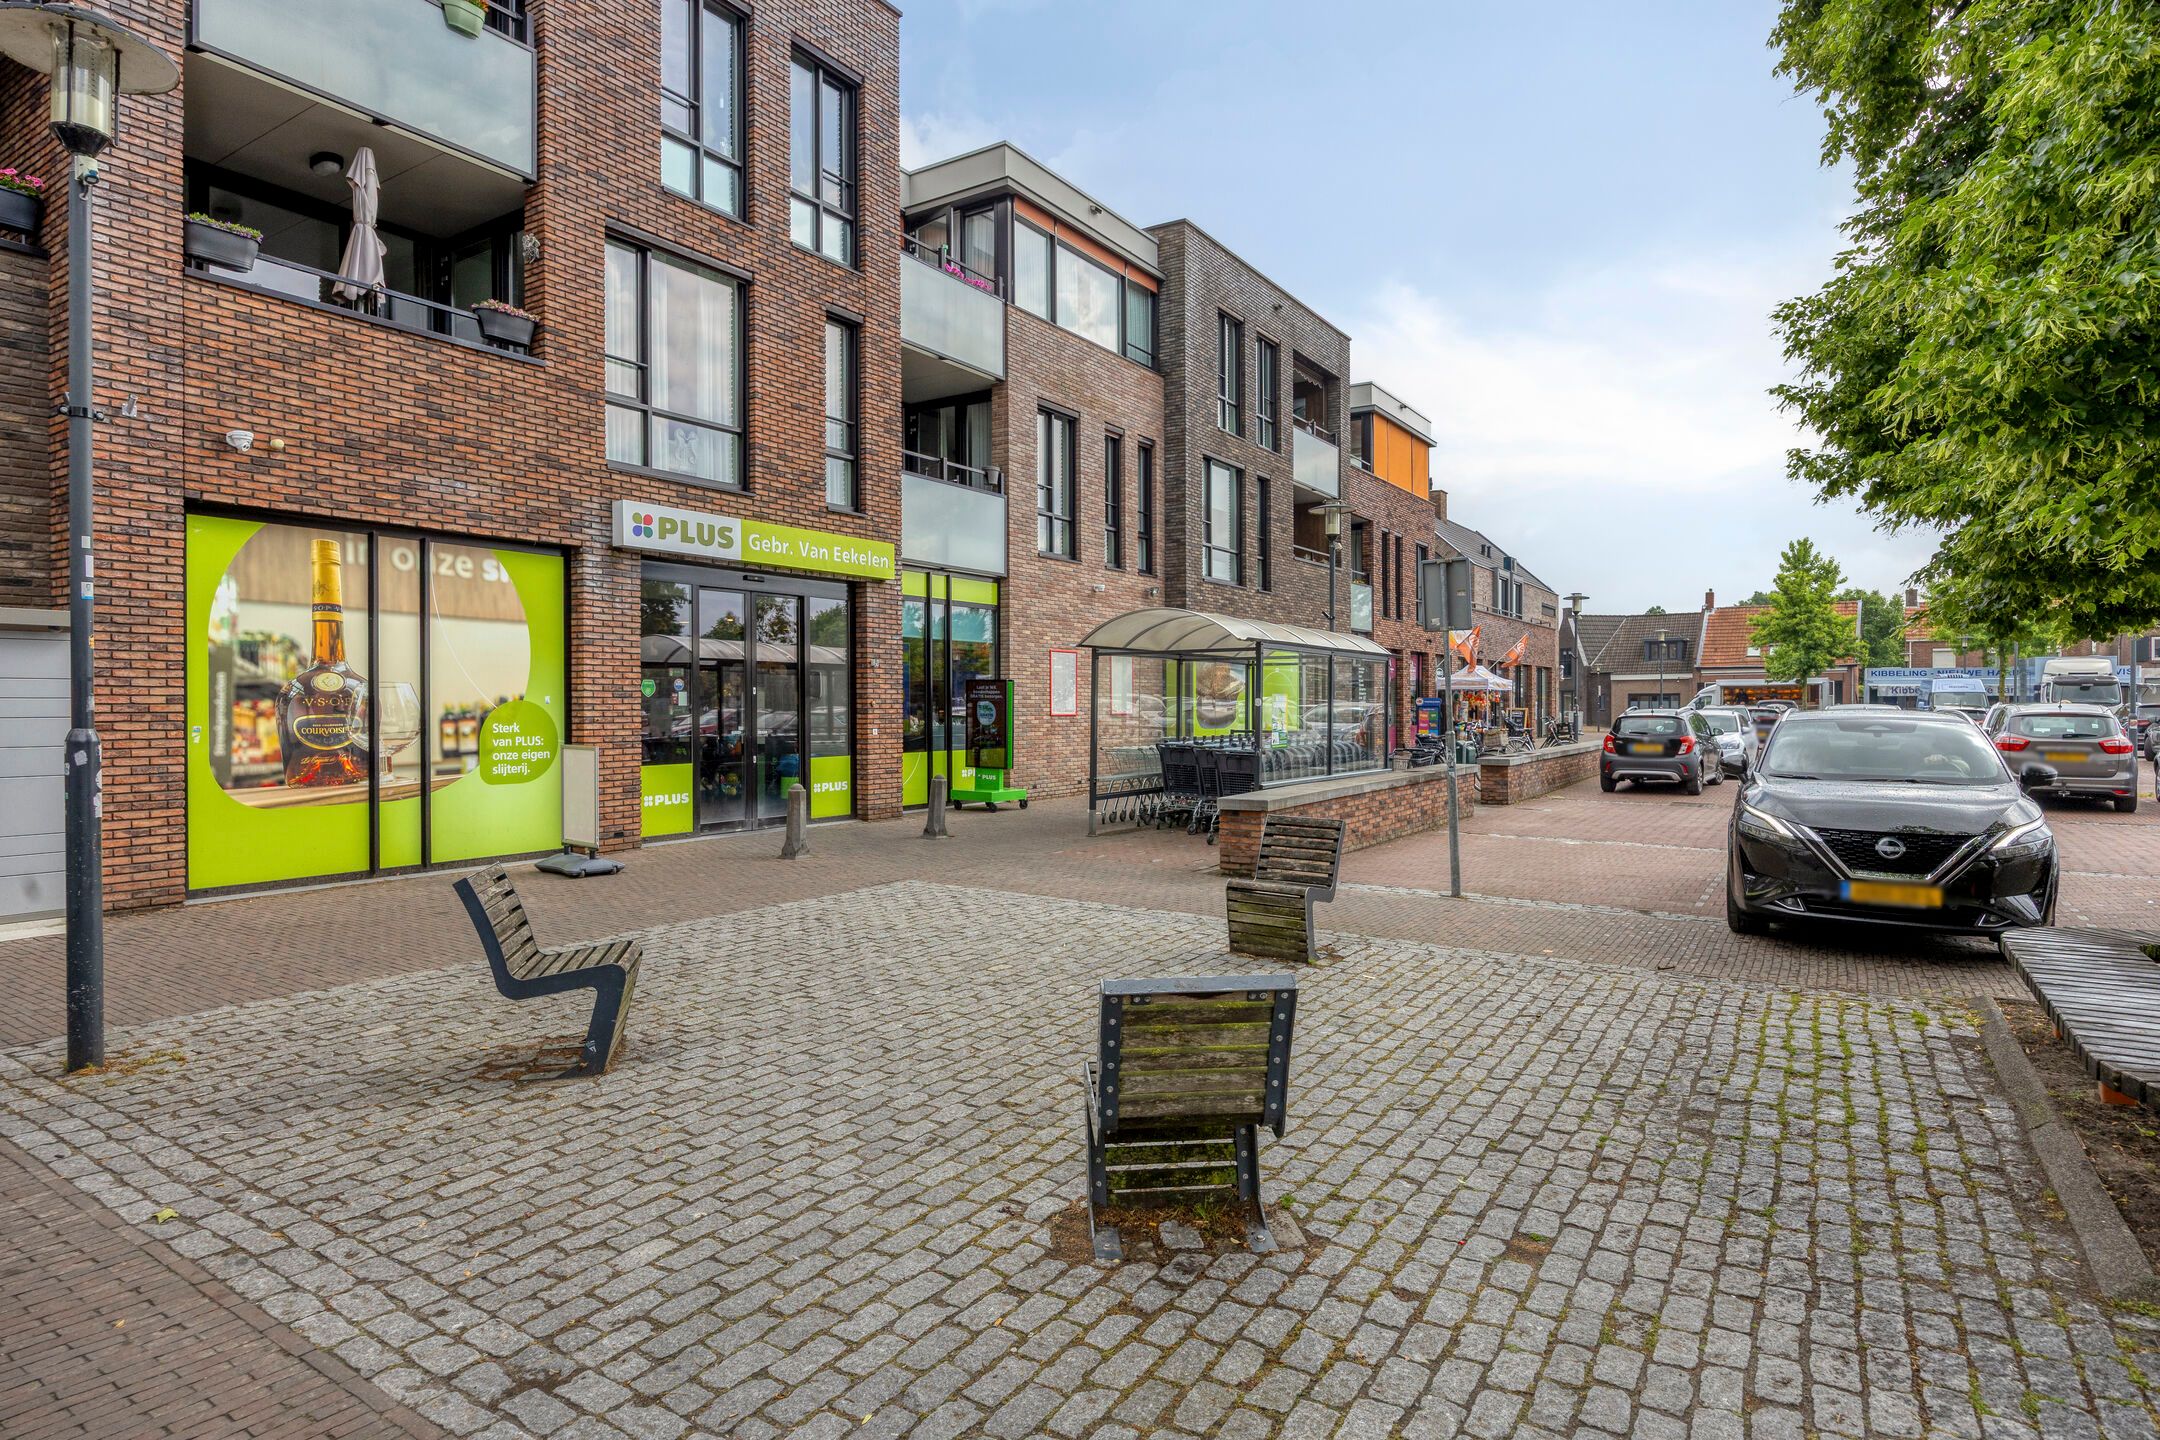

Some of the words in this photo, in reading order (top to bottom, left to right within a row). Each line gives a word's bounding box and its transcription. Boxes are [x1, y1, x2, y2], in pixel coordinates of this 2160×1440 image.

[657, 516, 734, 550] PLUS
[749, 534, 793, 556] Gebr.
[799, 541, 829, 561] Van
[833, 546, 890, 569] Eekelen
[1870, 669, 1927, 677] KIBBELING
[492, 722, 520, 733] Sterk
[492, 738, 512, 747] van
[515, 735, 544, 746] PLUS:
[492, 752, 518, 761] onze
[521, 749, 550, 762] eigen
[492, 762, 531, 776] slijterij.
[821, 780, 848, 792] PLUS
[654, 792, 690, 807] PLUS
